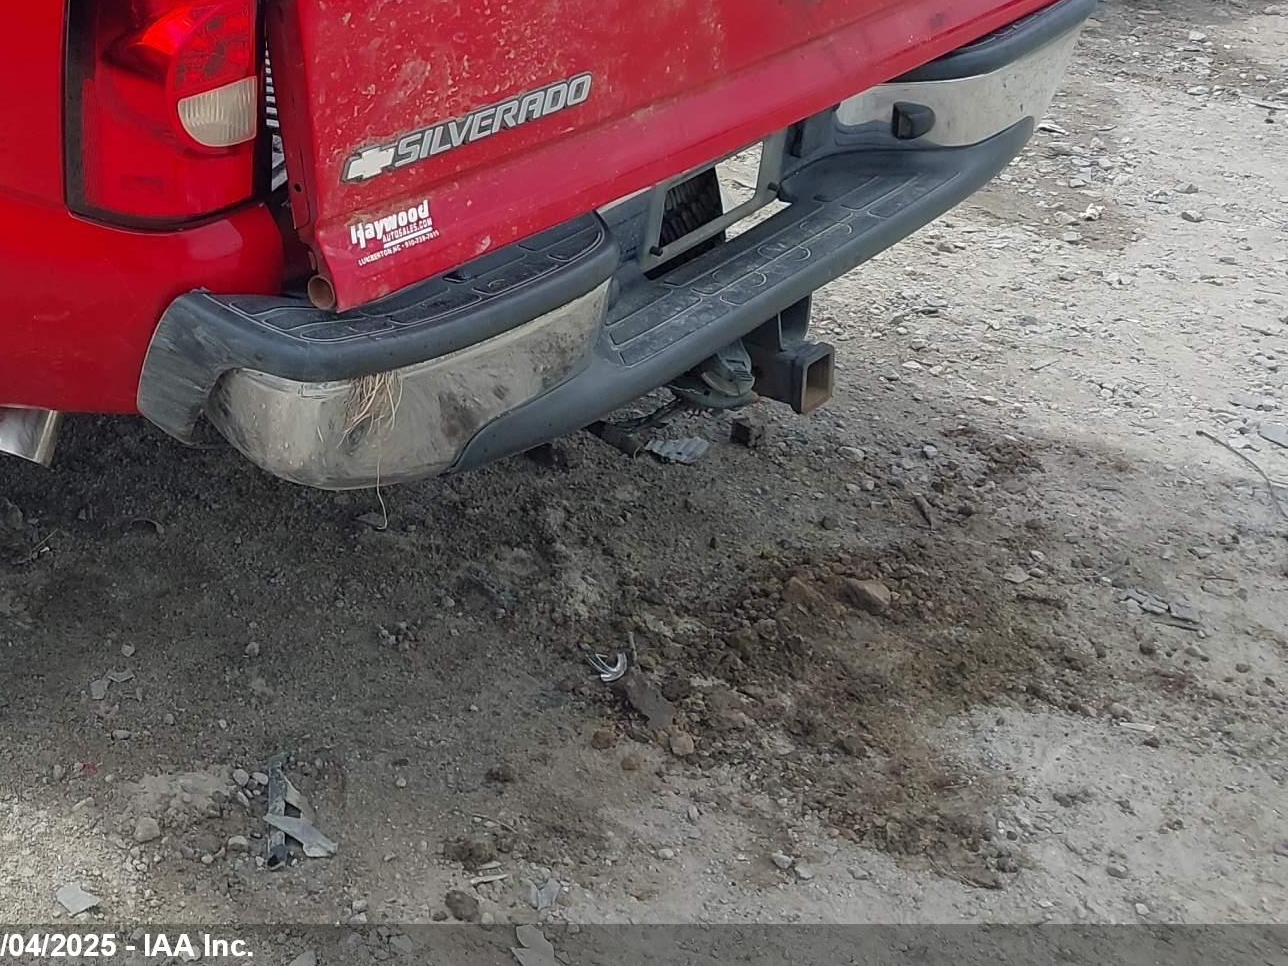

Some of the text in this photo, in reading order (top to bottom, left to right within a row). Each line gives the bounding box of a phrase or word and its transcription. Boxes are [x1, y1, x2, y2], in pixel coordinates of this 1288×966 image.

[394, 73, 592, 167] SILVERADO
[350, 199, 429, 249] Haywood
[382, 217, 433, 243] AUTOSALES.COM
